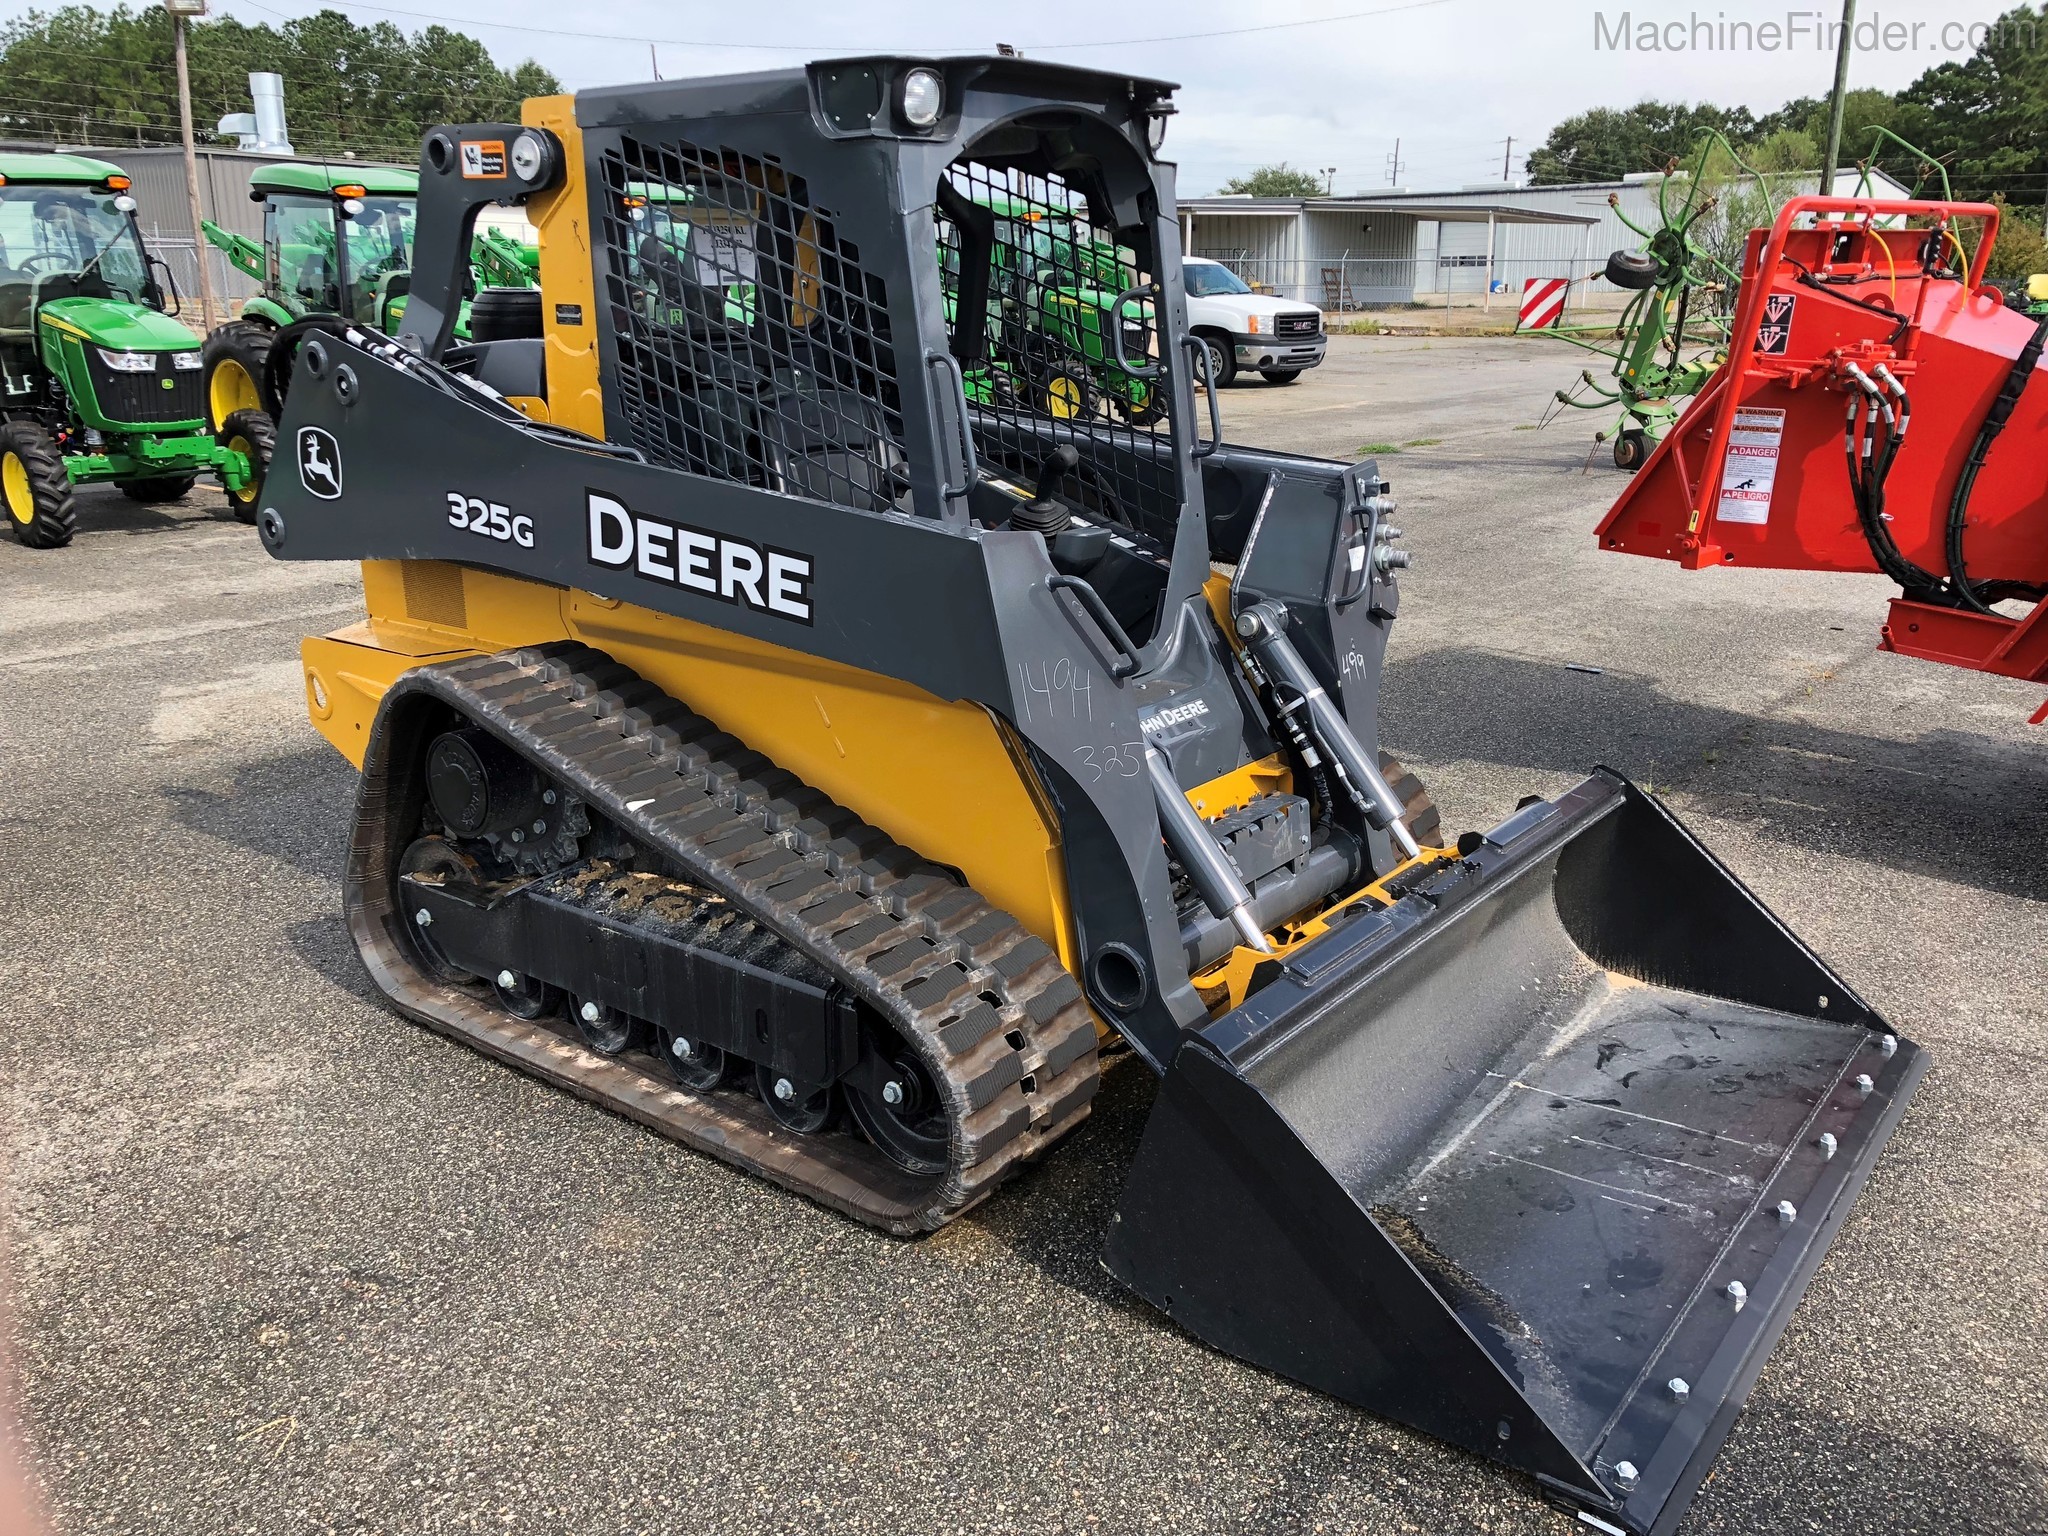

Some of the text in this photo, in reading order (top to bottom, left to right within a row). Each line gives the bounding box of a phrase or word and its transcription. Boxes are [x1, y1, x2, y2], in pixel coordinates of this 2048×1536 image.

[1745, 408, 1783, 417] WARNING
[1740, 425, 1780, 434] ADVERTENCIA
[1739, 447, 1777, 457] DANGER
[1731, 491, 1769, 501] PELIGRO
[446, 492, 535, 548] 325G
[588, 493, 810, 620] DEERE
[1018, 657, 1093, 723] 1494
[1160, 699, 1210, 726] DEERE
[1073, 741, 1145, 783] 325
